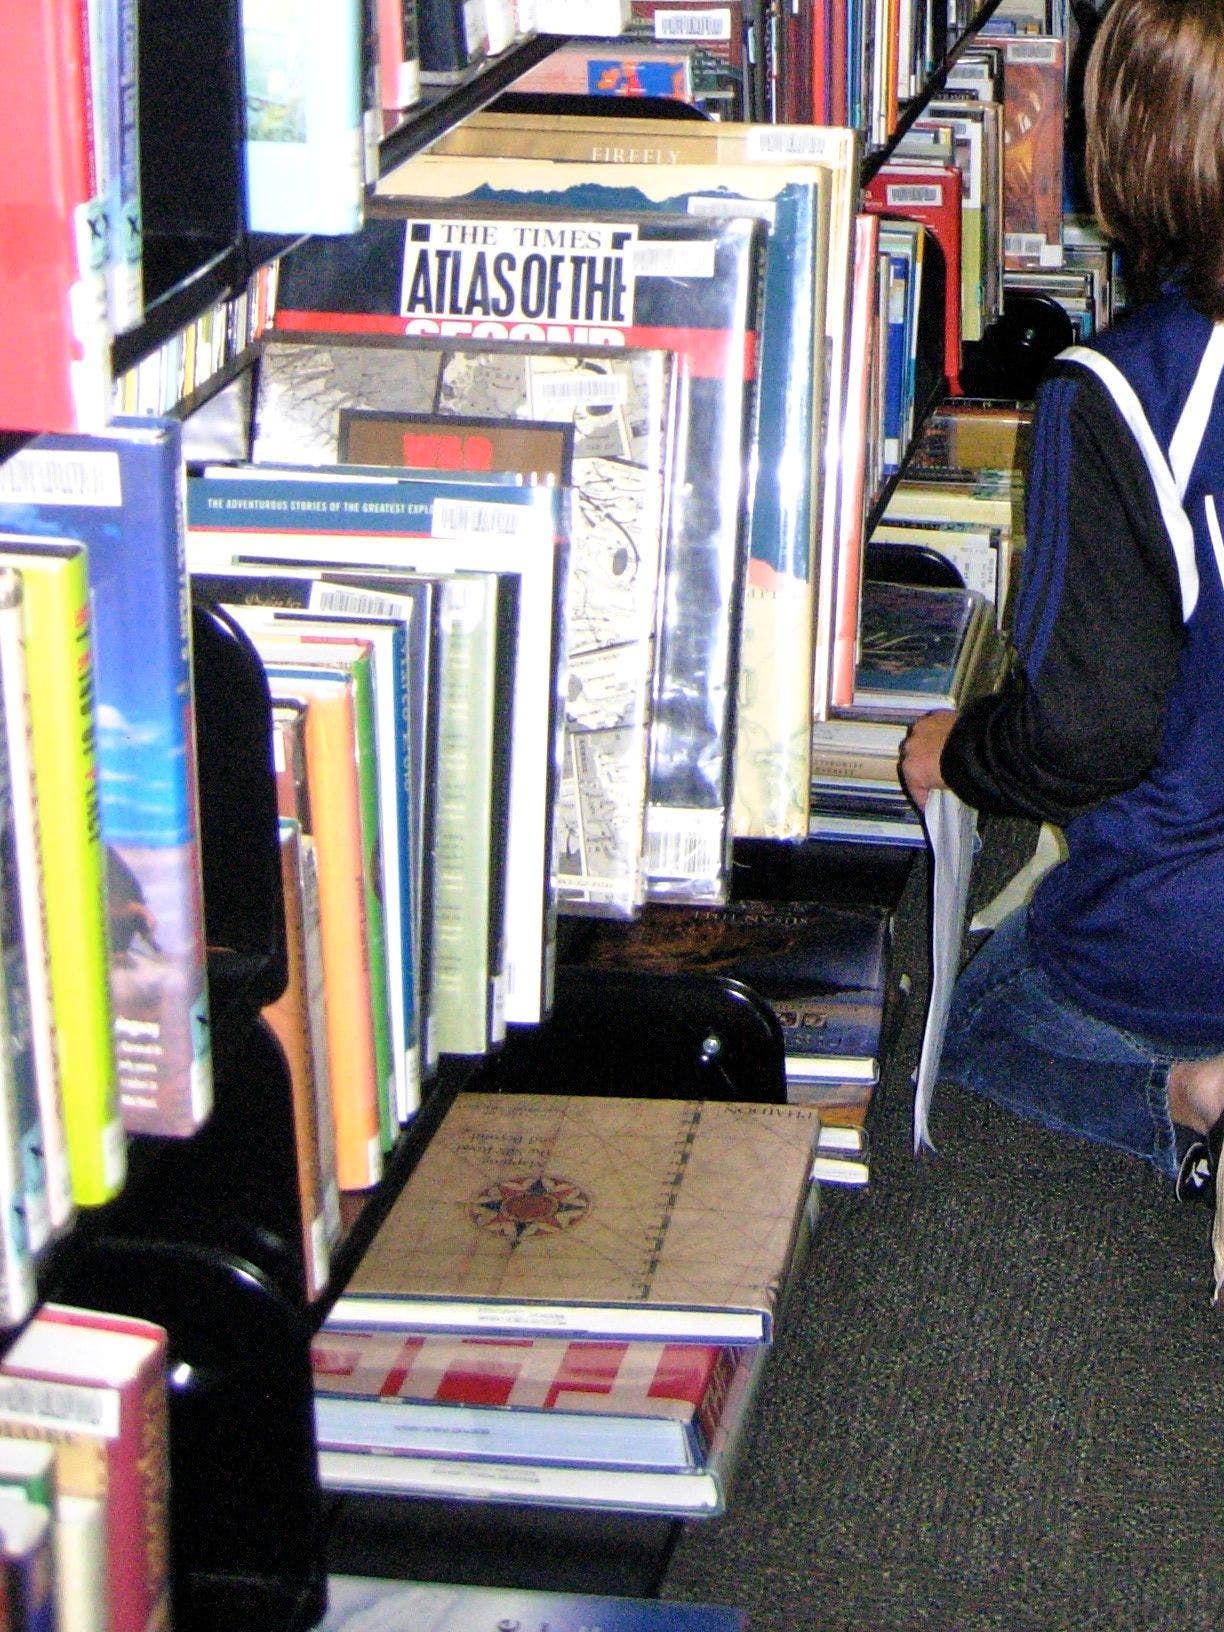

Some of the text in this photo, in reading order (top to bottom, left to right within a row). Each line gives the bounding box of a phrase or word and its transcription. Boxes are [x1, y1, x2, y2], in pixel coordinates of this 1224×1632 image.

[591, 147, 680, 166] FIREFLY
[441, 224, 602, 250] THE TIMES
[407, 248, 626, 322] ATLAS OF THE
[207, 497, 224, 510] THE
[226, 499, 288, 511] ADVENTUROUS
[290, 500, 327, 513] STORIES
[330, 501, 340, 513] OF
[344, 501, 360, 513] THE
[363, 502, 405, 515] GREATEST
